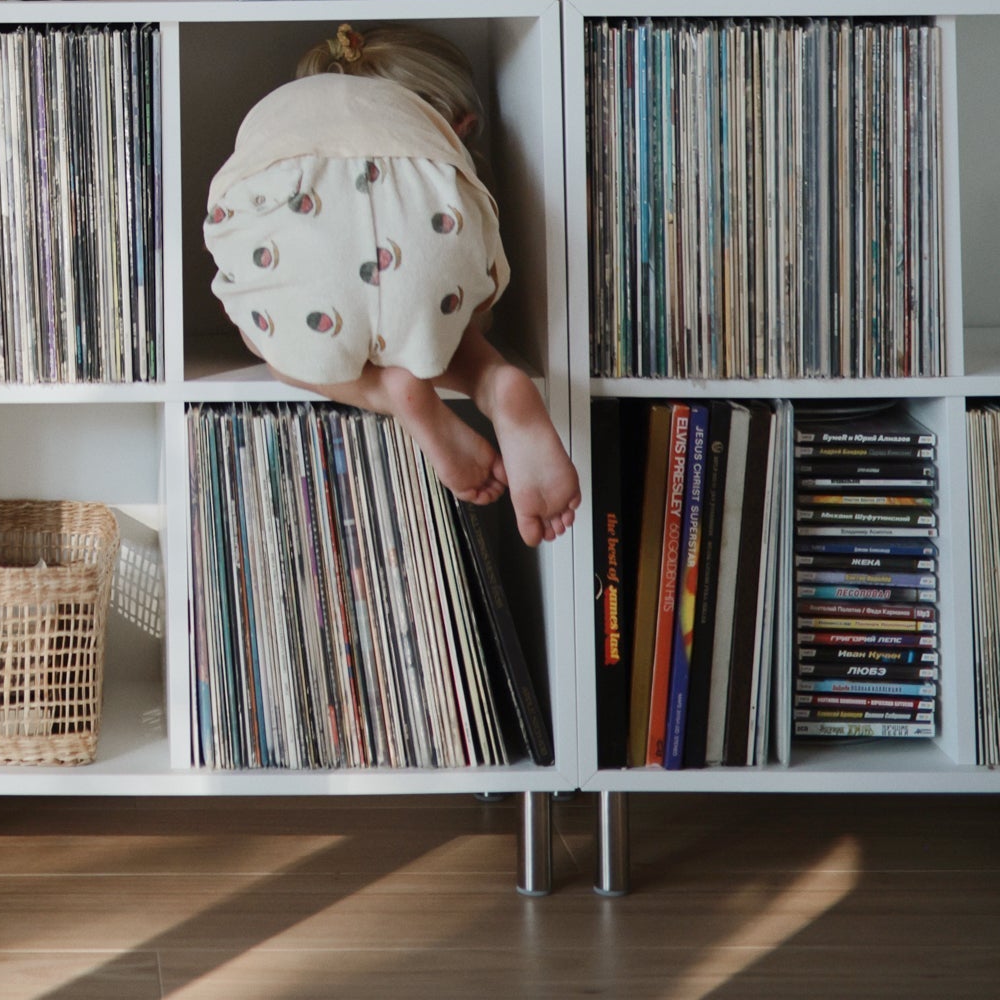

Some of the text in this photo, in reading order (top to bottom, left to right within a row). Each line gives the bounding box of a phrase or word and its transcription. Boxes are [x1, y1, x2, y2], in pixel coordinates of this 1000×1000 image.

[675, 416, 688, 454] ELVIS
[854, 434, 877, 443] Юрий
[670, 456, 685, 517] PRESLEY
[687, 425, 703, 568] JESUS CHRIST SUPERSTAR
[607, 538, 618, 566] best
[607, 568, 619, 582] of
[609, 632, 620, 659] last
[830, 635, 876, 643] ГРИГОРИЙ
[838, 650, 866, 658] Иван
[847, 666, 887, 676] ЛЮБЭ
